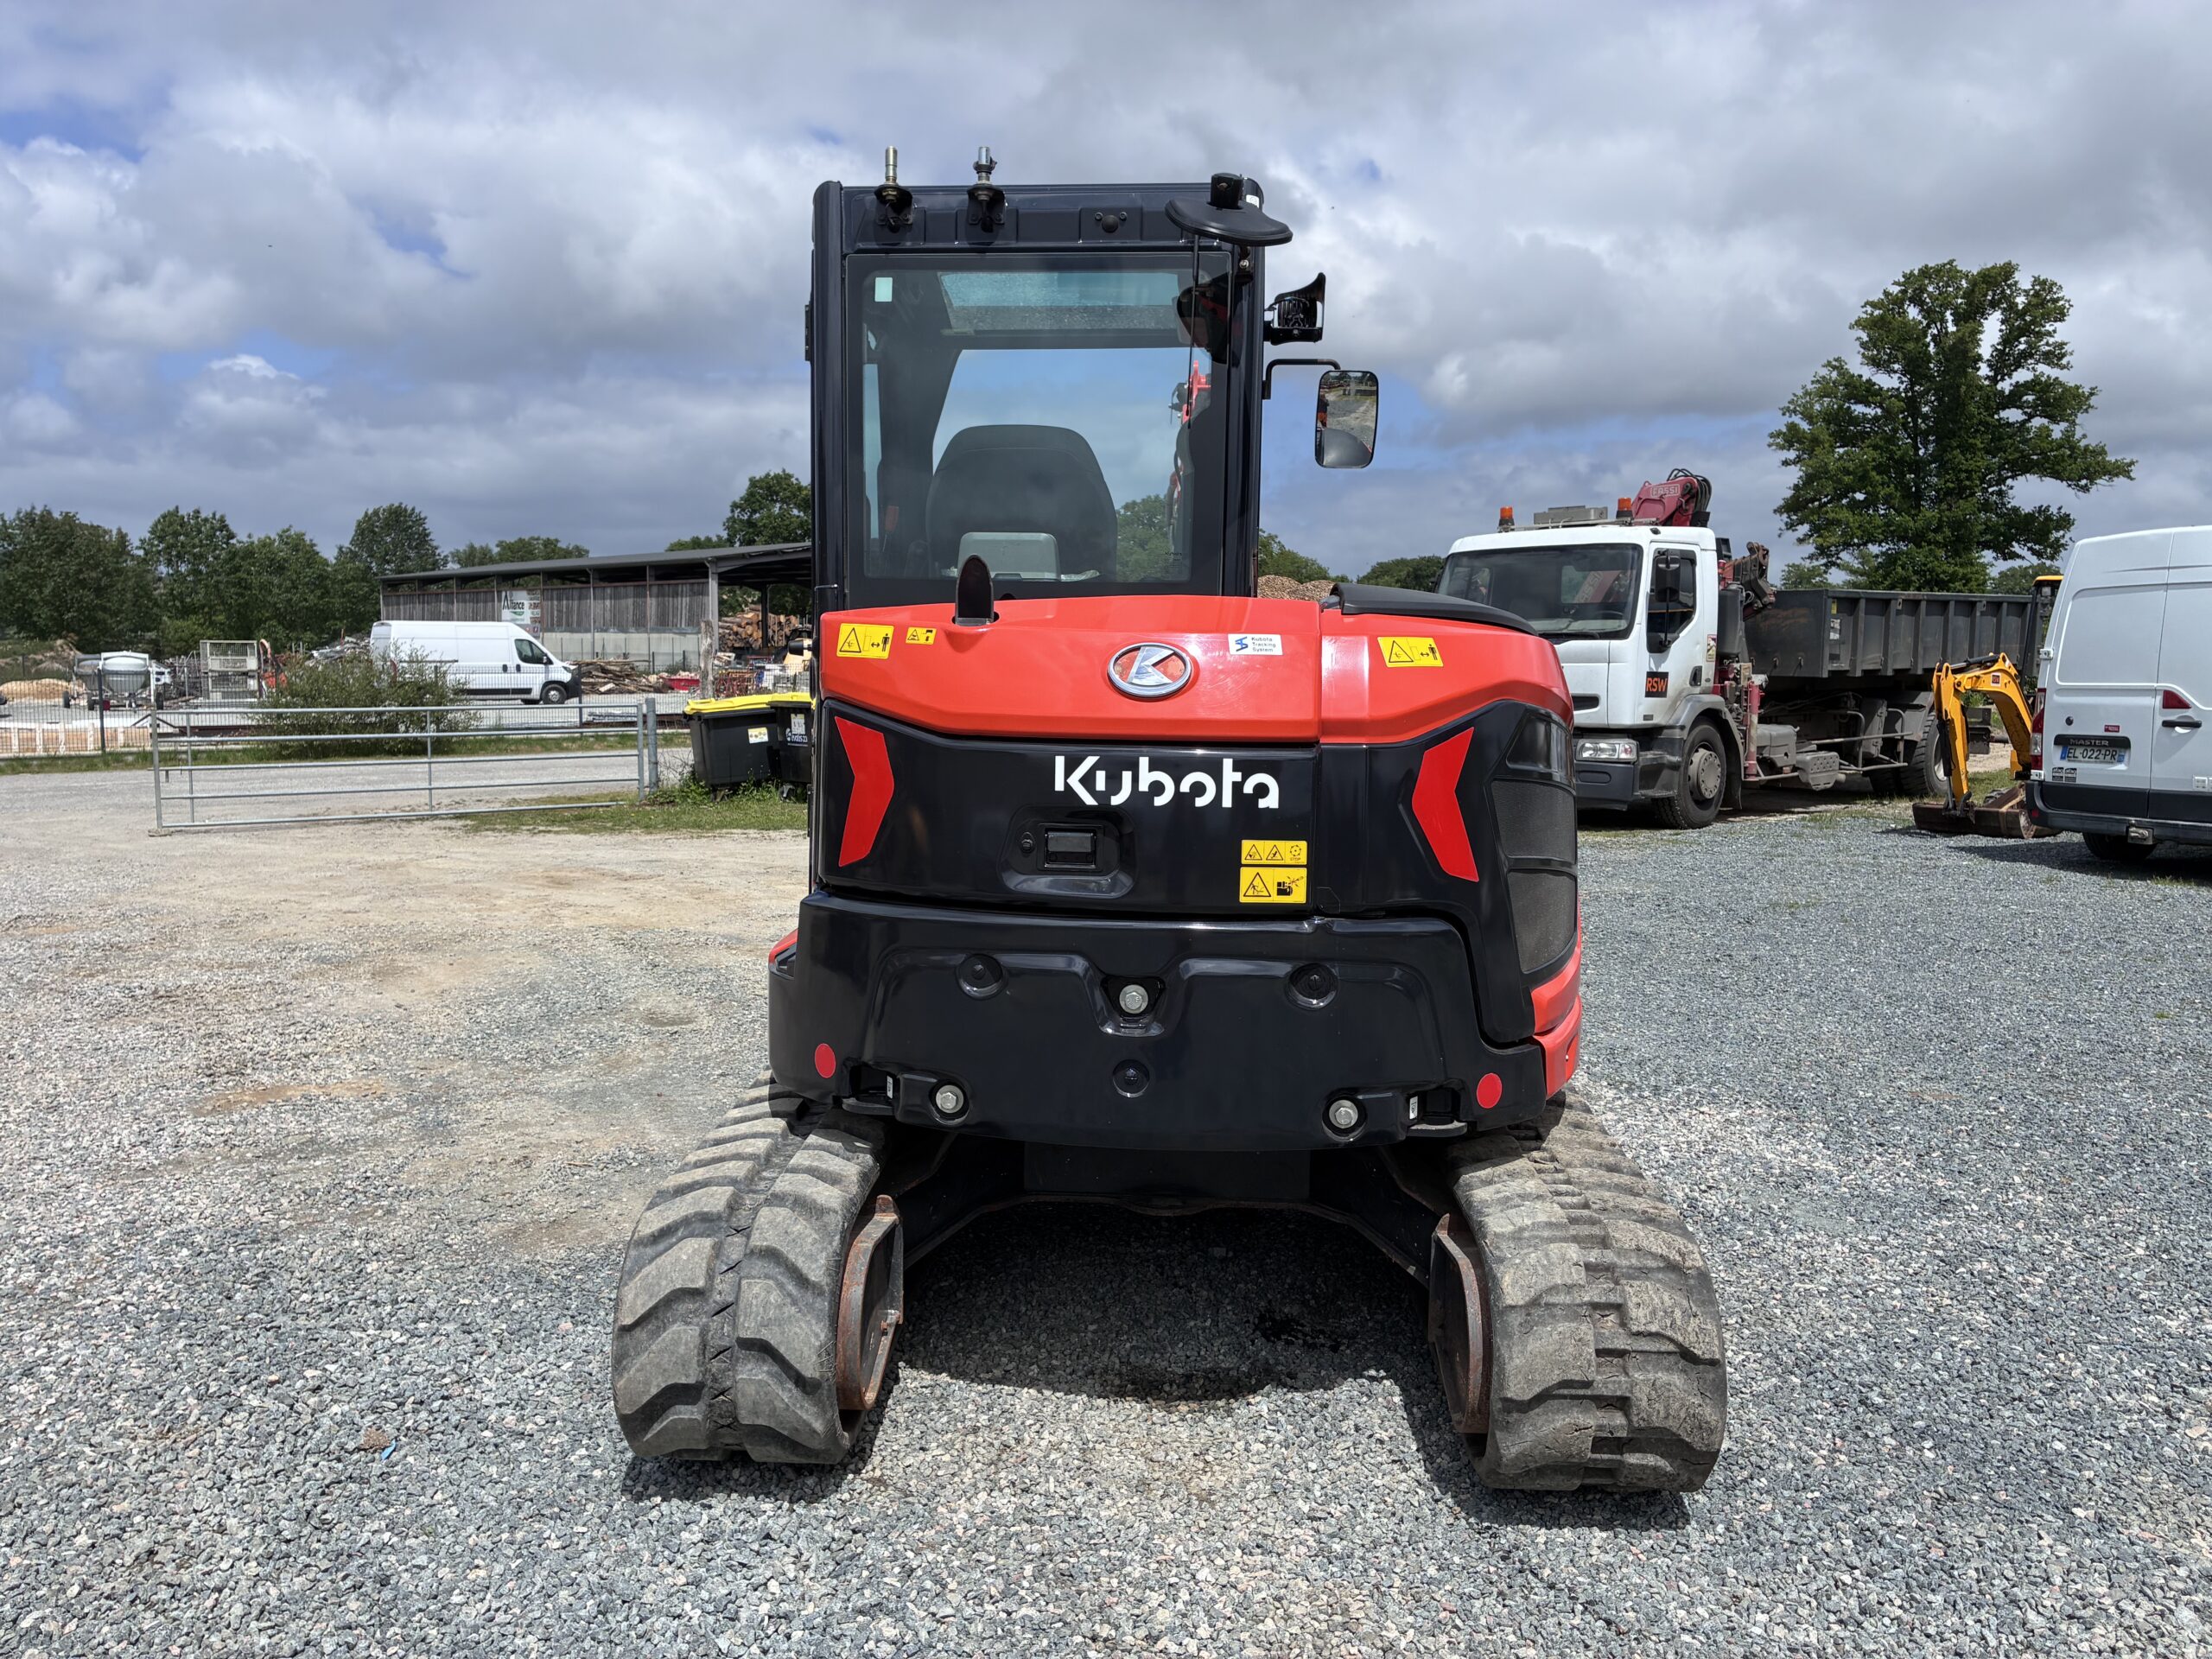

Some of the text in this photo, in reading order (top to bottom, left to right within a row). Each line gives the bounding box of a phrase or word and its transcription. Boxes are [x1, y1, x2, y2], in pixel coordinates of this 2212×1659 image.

[1652, 486, 1678, 497] FASSI
[1646, 677, 1668, 692] RSW
[1054, 755, 1280, 809] Kubota
